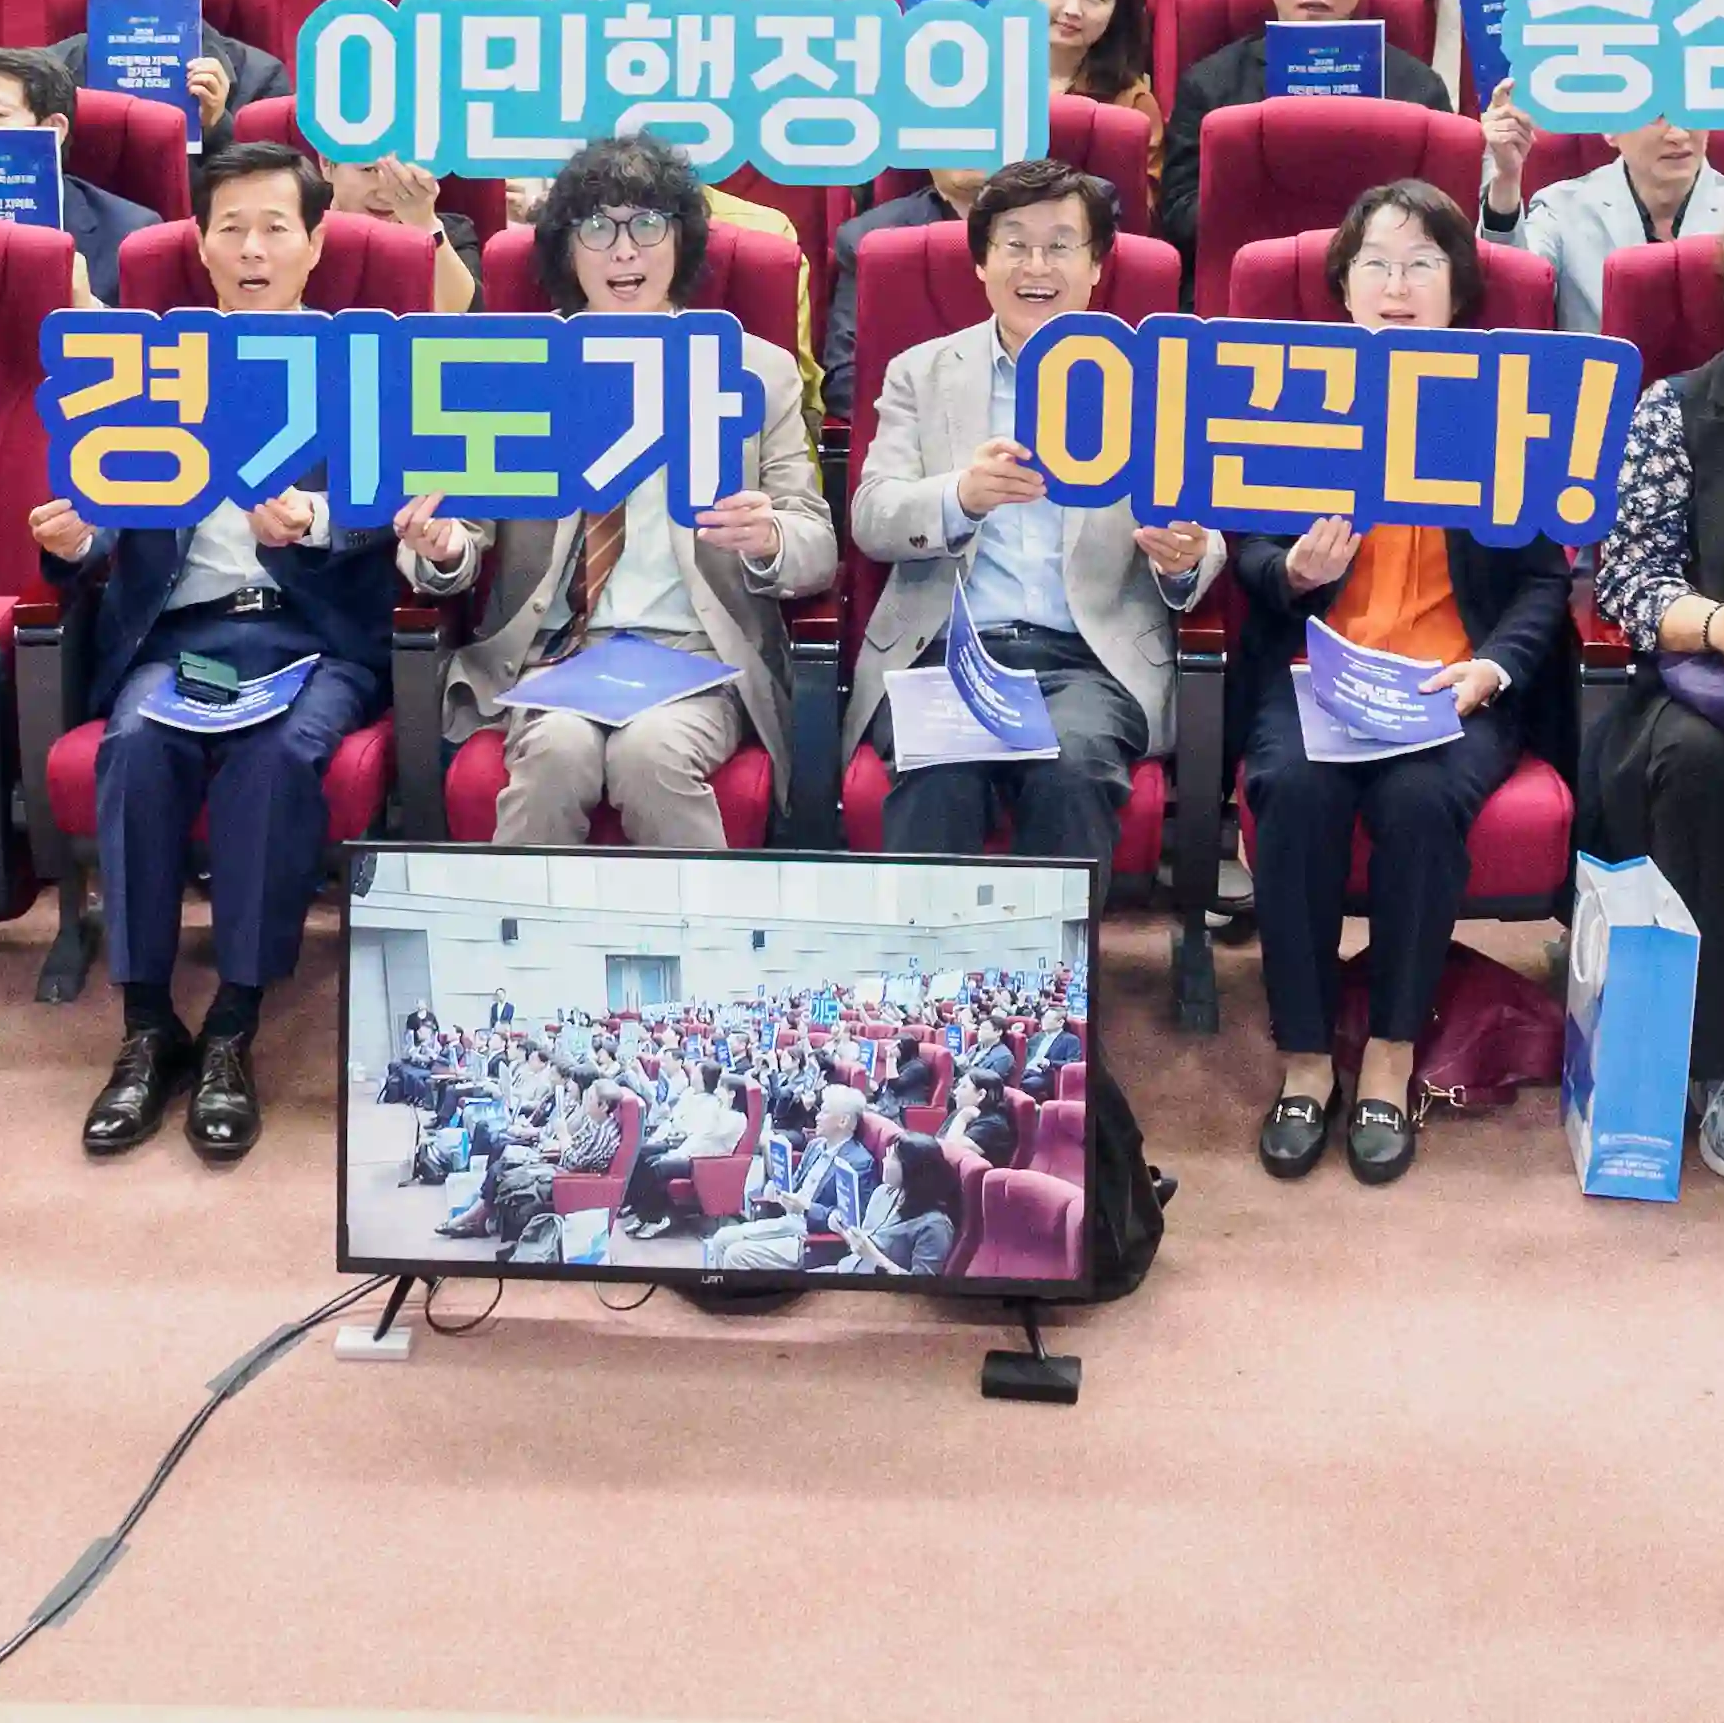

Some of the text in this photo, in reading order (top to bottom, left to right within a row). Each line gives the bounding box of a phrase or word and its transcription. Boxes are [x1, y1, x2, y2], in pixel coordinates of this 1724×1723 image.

[314, 3, 1029, 166] 이민행정의
[58, 332, 743, 507] 경기도가
[1036, 335, 1618, 525] 이끈다!
